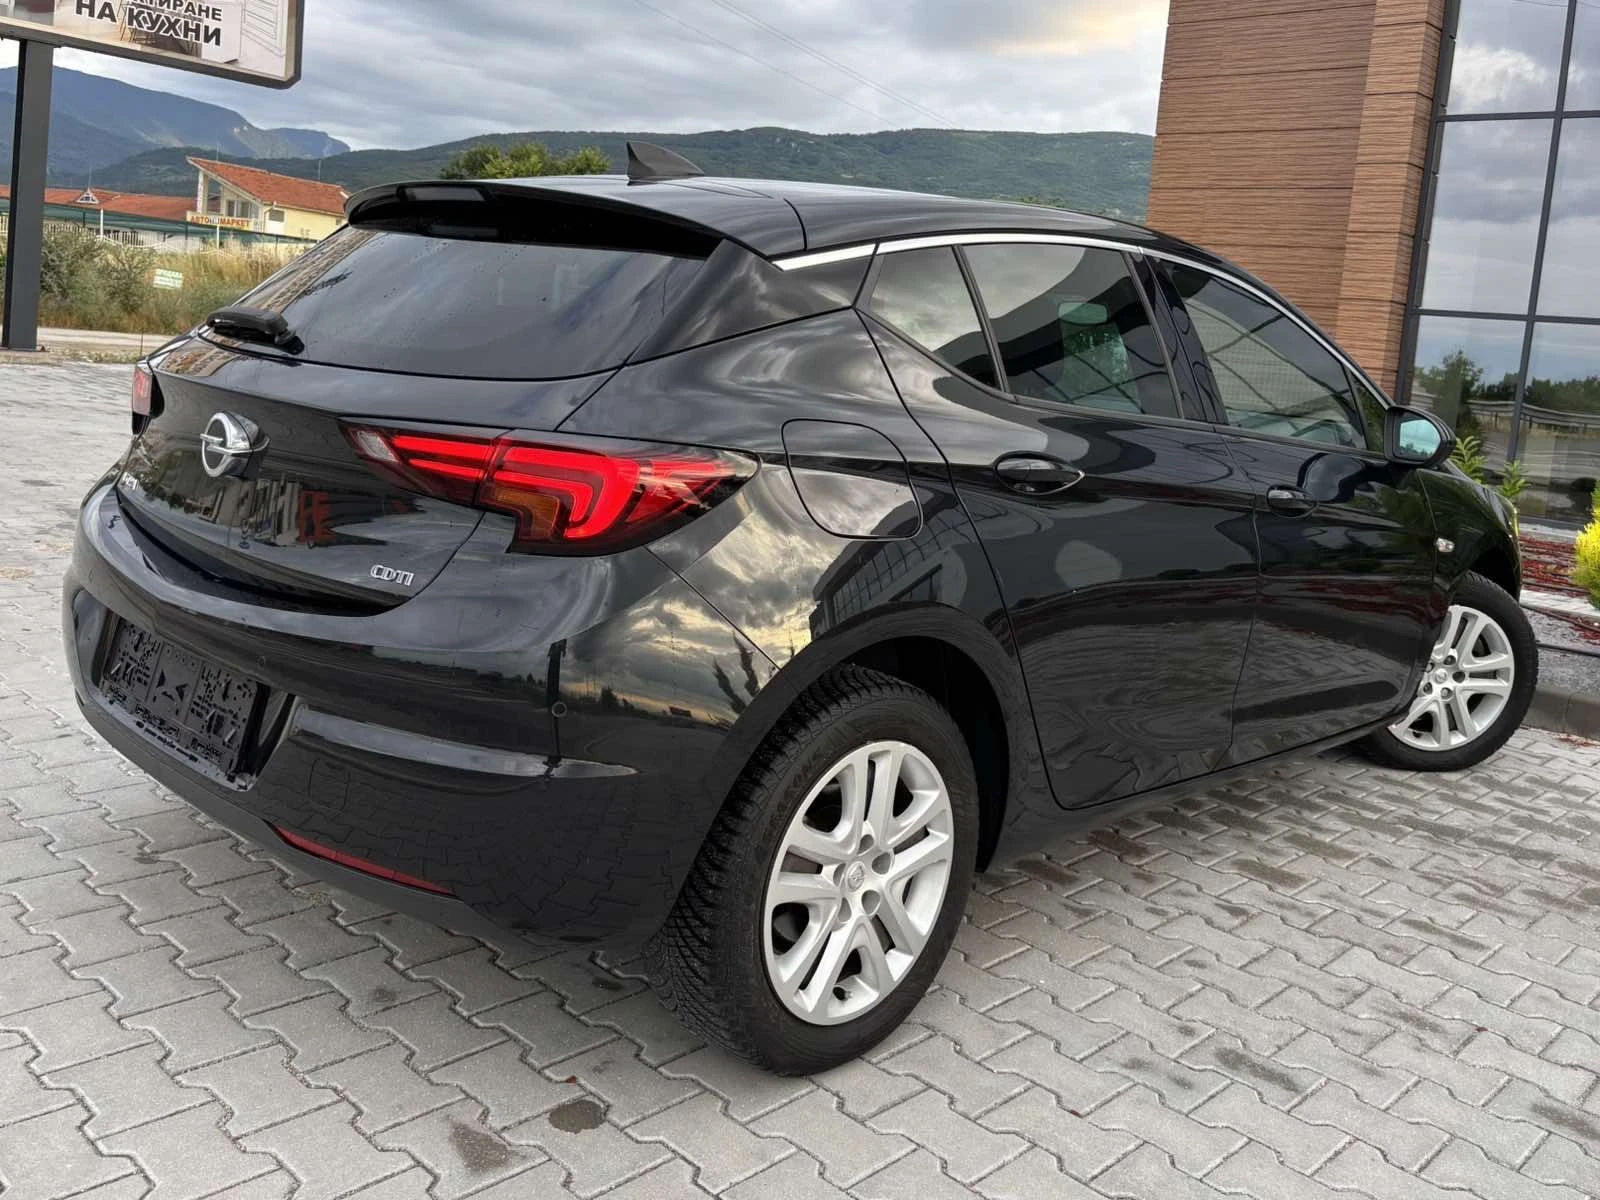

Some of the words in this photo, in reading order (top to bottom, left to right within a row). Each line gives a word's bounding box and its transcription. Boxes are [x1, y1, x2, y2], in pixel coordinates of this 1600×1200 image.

[75, 0, 117, 23] НА
[127, 7, 221, 46] КУХНИ
[370, 564, 414, 586] CDTI
